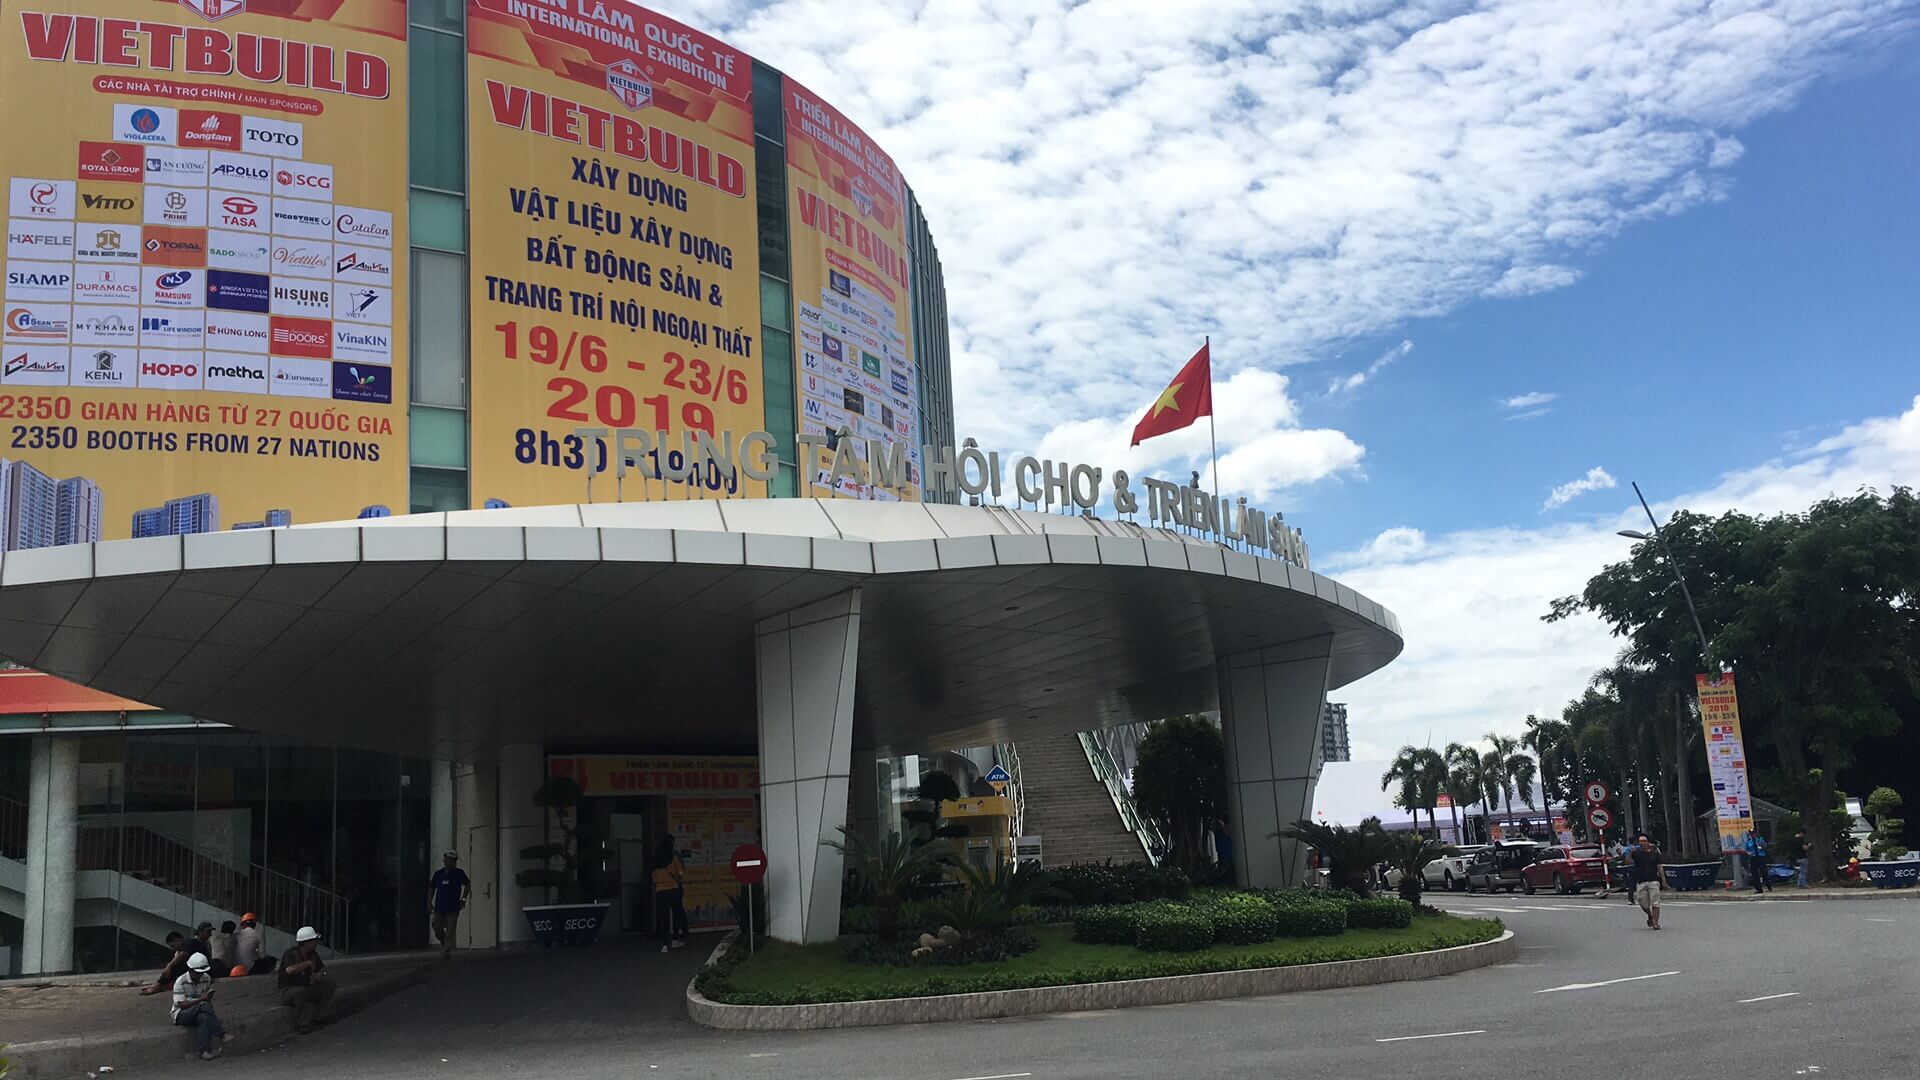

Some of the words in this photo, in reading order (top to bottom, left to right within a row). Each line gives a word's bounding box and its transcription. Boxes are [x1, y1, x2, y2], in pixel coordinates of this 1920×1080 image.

[507, 0, 643, 55] INTERNATIONAL
[648, 44, 727, 90] EXHIBITION
[644, 24, 705, 62] QUỐC
[711, 51, 735, 76] TẾ
[20, 12, 389, 100] VIETBUILD
[608, 75, 651, 96] VIETBUILD
[99, 78, 124, 91] CÁC
[126, 79, 151, 93] NHÀ
[154, 82, 173, 95] TÀI
[176, 86, 199, 99] TRỢ
[201, 86, 236, 100] CHÍNH
[245, 95, 268, 105] MAIN
[269, 98, 319, 113] SPONSORS
[123, 132, 167, 143] VIGLACERA
[184, 131, 233, 144] Dongtam
[246, 128, 300, 147] TOTO
[484, 79, 746, 198] VIETBUILD
[801, 116, 867, 172] INTERNATIONAL
[81, 164, 110, 173] ROYAL
[111, 165, 140, 174] GROUP
[162, 161, 175, 169] AN
[211, 164, 269, 178] APOLLO
[296, 175, 331, 189] SCG
[570, 156, 619, 191] XÂY
[629, 173, 688, 212] DỰNG
[31, 205, 56, 213] TTC
[163, 213, 188, 221] PRIME
[221, 215, 257, 228] TASA
[274, 212, 321, 223] VICOSTONE
[336, 214, 390, 237] Catalan
[510, 187, 560, 222] VẬT
[567, 202, 621, 236] LIỆU
[630, 216, 673, 249] XÂY
[680, 231, 732, 270] DỰNG
[9, 233, 72, 246] HÄFELE
[160, 240, 203, 250] TOPAL
[527, 235, 577, 269] BẤT
[585, 249, 651, 287] ĐỘNG
[660, 265, 702, 301] SẢN
[708, 284, 723, 307] &
[8, 272, 70, 286] SIAMP
[76, 283, 138, 292] DURAMACS
[274, 286, 329, 303] HISUNG
[155, 291, 192, 300] NAMSUNG
[485, 275, 562, 312] TRANG
[569, 291, 603, 320] TRÍ
[610, 299, 645, 333] NỘI
[653, 309, 707, 348] NGOẠI
[712, 326, 753, 358] THẤT
[95, 324, 135, 333] KHANG
[217, 325, 243, 336] HÙNG
[244, 329, 268, 339] LONG
[289, 332, 326, 345] DOORS
[337, 332, 387, 347] VinaKIN
[142, 362, 198, 377] HOPO
[495, 321, 608, 373] 19/6
[627, 361, 646, 371] -
[663, 352, 748, 404] 23/6
[85, 371, 122, 381] KENLI
[208, 365, 265, 380] metha
[0, 395, 72, 420] 2350
[81, 401, 138, 422] GIAN
[146, 401, 210, 424] HÀNG
[218, 402, 249, 426] TỪ
[255, 408, 282, 427] 27
[289, 406, 350, 432] QUỐC
[357, 415, 393, 435] GIA
[546, 377, 715, 441] 2019
[11, 425, 78, 450] 2350
[87, 430, 178, 453] BOOTHS
[187, 432, 249, 455] FROM
[257, 435, 282, 456] 27
[289, 436, 380, 462] NATIONS
[573, 427, 779, 482] TRUNG
[796, 425, 907, 488] TÂM
[923, 437, 1001, 507] HỘI
[1016, 456, 1102, 517] CHỢ
[1113, 470, 1139, 514] &
[1142, 471, 1220, 536] TRIỂN
[1221, 496, 1269, 550] LÃM
[1709, 704, 1729, 712] 2019
[609, 771, 740, 790] VIETBUILD
[1593, 788, 1600, 799] 5
[1691, 868, 1711, 878] SECC
[1894, 868, 1916, 878] SECC
[565, 918, 597, 930] SECC
